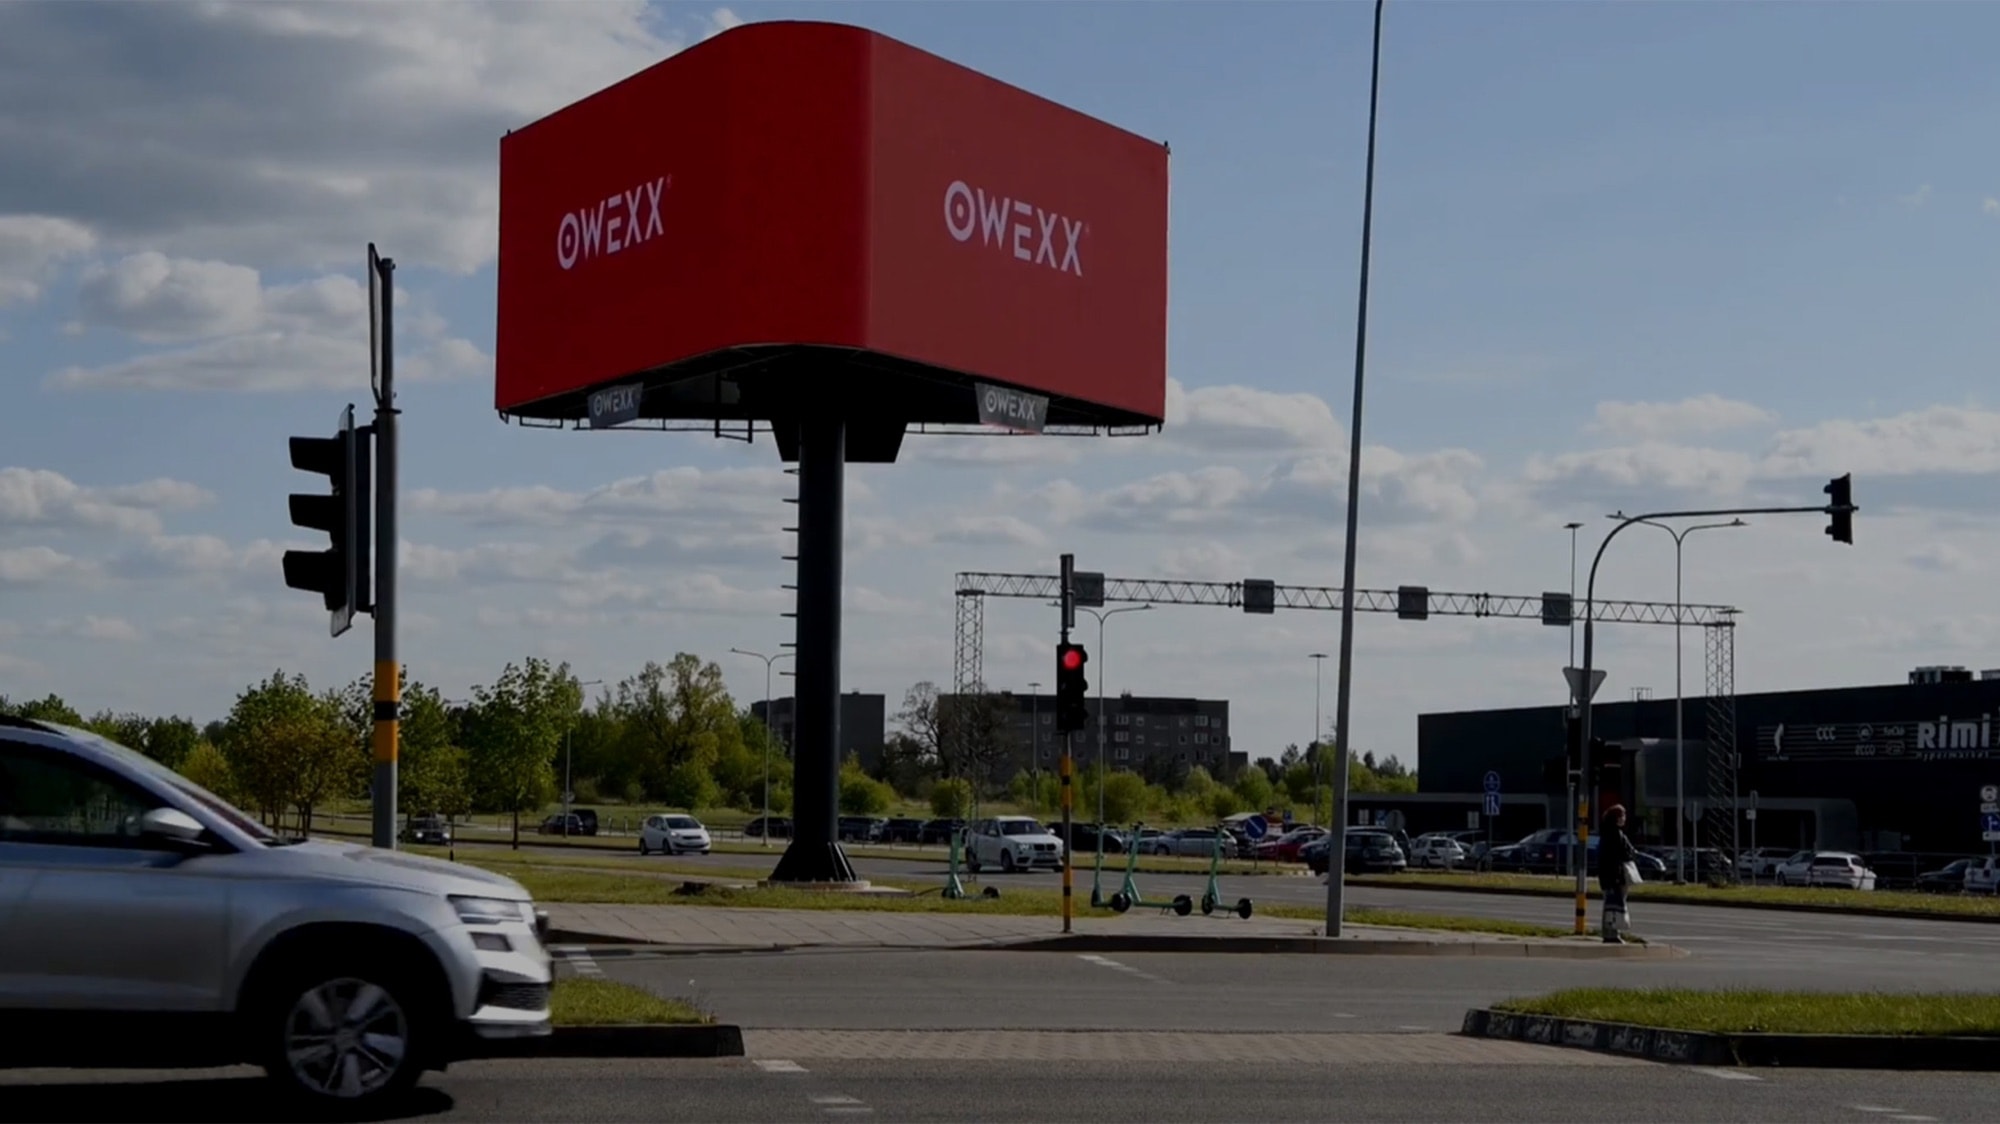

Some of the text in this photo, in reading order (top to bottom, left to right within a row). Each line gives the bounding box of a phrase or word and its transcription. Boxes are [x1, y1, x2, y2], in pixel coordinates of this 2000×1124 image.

[557, 175, 665, 271] OWEXX
[943, 180, 1083, 277] OWEXX
[592, 388, 635, 417] OWEXX
[984, 389, 1036, 422] OWEXX
[1916, 712, 1991, 749] Rimi
